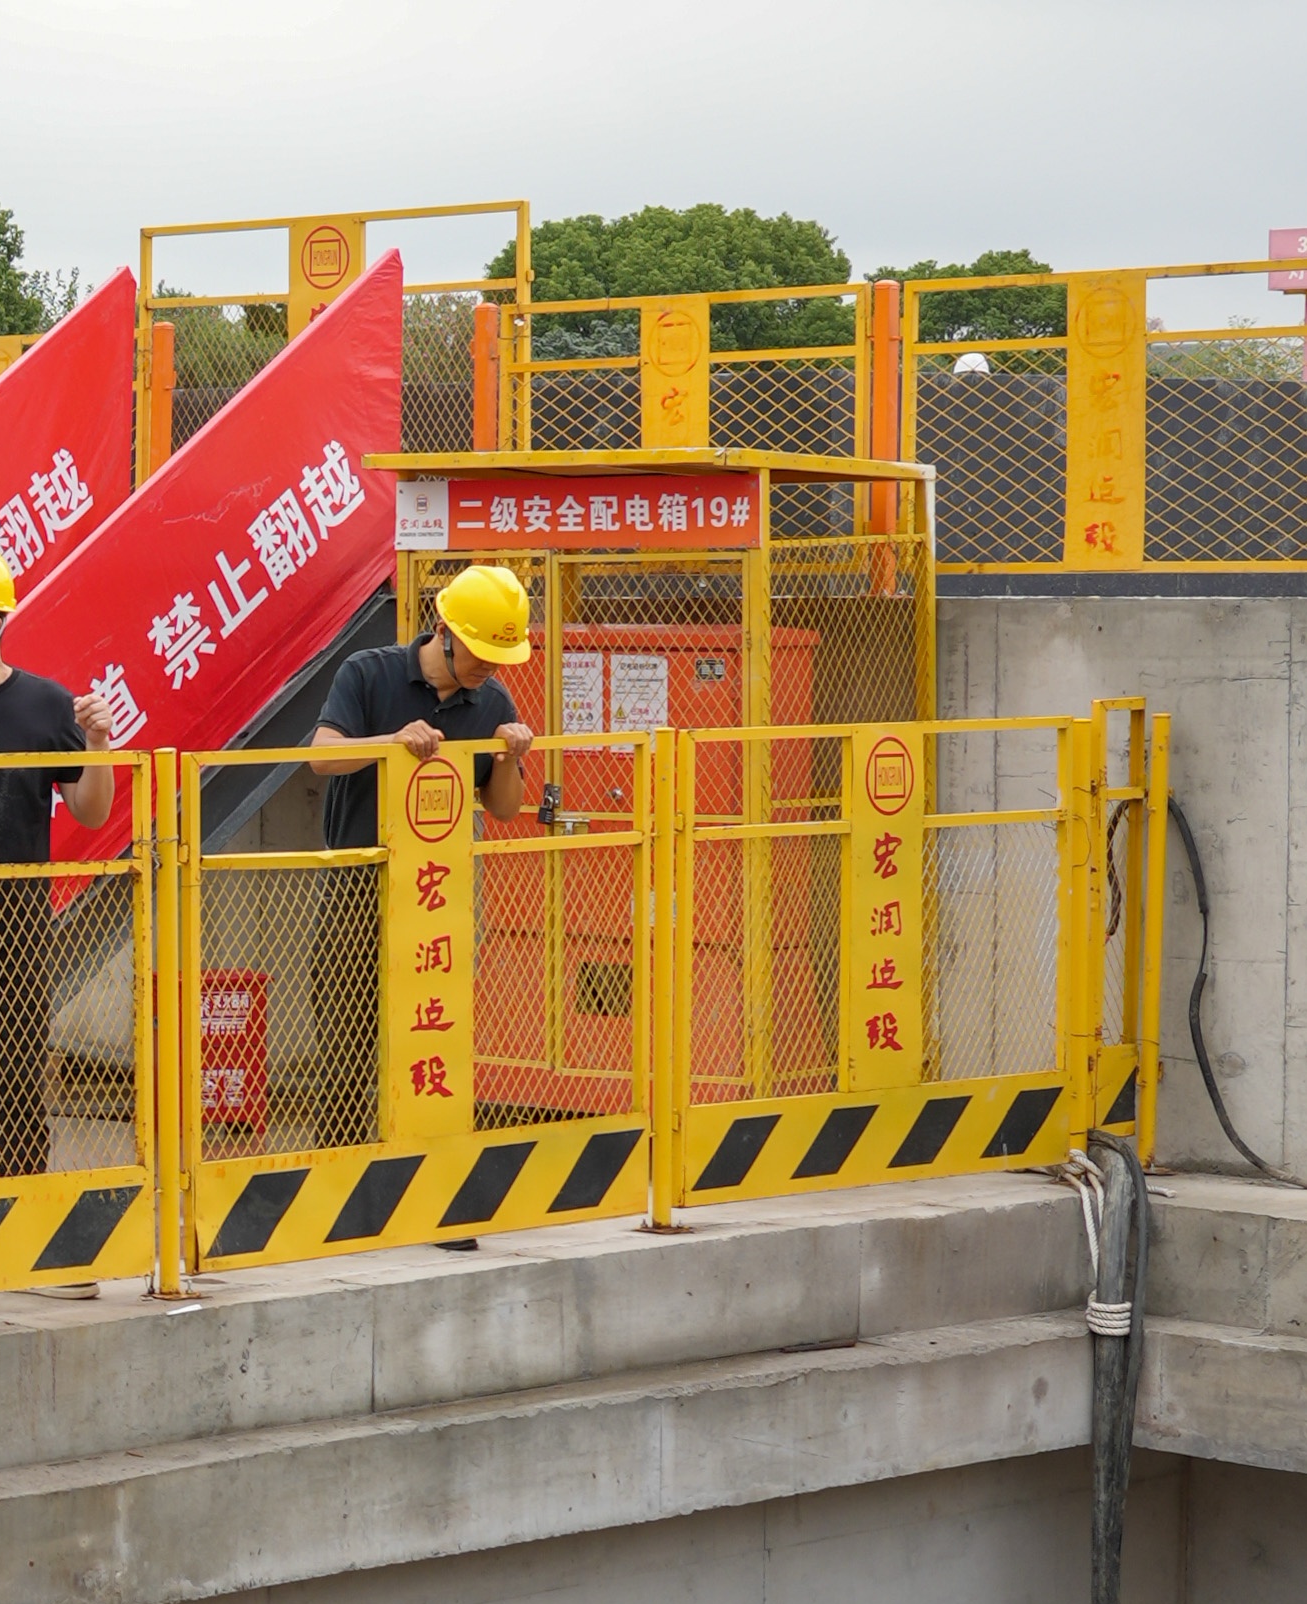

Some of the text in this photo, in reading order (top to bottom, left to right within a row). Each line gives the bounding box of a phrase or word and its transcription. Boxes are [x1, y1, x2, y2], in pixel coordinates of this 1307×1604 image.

[147, 439, 366, 691] 禁止翻越
[457, 493, 750, 533] 二级安全配电箱19#
[419, 788, 450, 812] HONGRUN
[877, 765, 903, 788] HONGRUN
[410, 861, 454, 1097] 宏润建设
[866, 832, 903, 1051] 宏润建设
